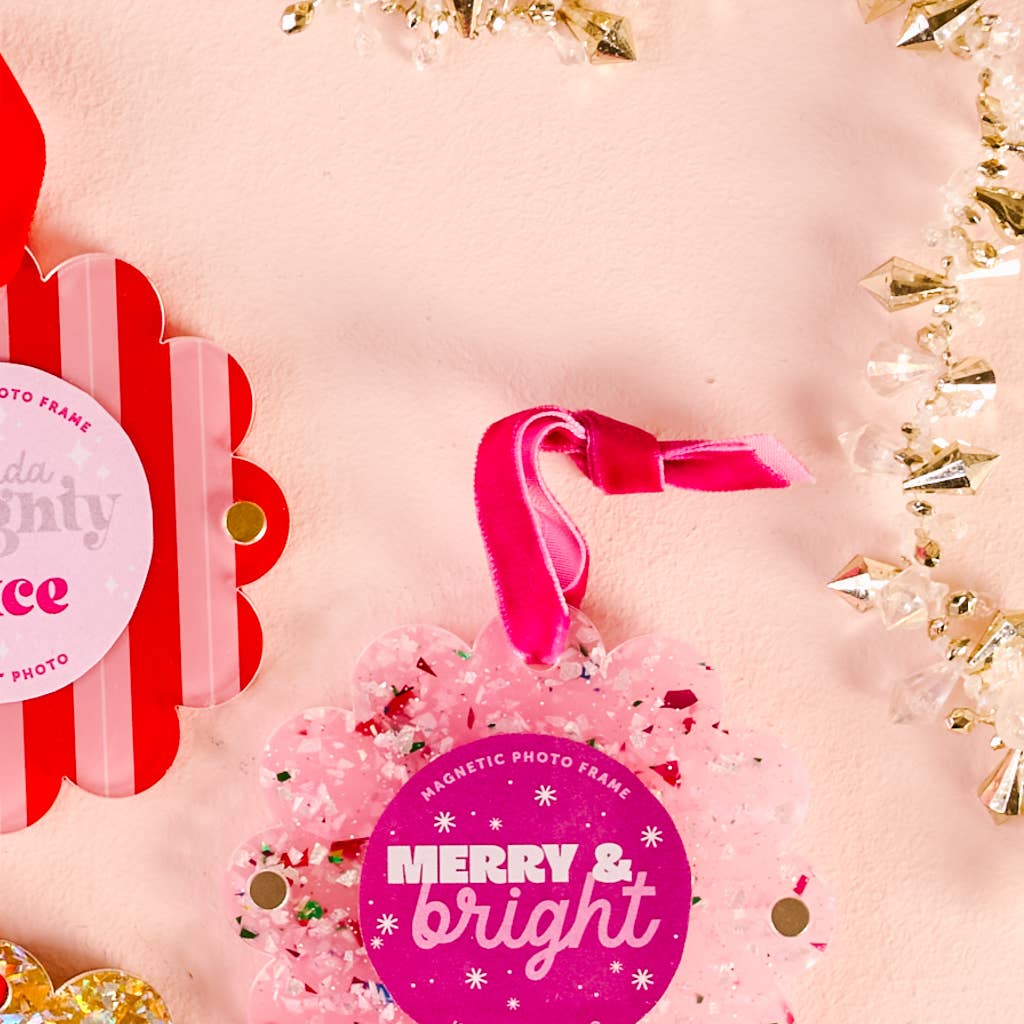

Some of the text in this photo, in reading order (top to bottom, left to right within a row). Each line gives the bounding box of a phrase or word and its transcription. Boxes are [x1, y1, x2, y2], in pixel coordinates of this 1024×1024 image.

[39, 397, 91, 433] FRAME
[12, 653, 68, 682] PHOTO
[420, 751, 632, 802] MAGNETIC PHOTO FRAME
[387, 843, 632, 884] MERRY &
[412, 871, 662, 981] bright
